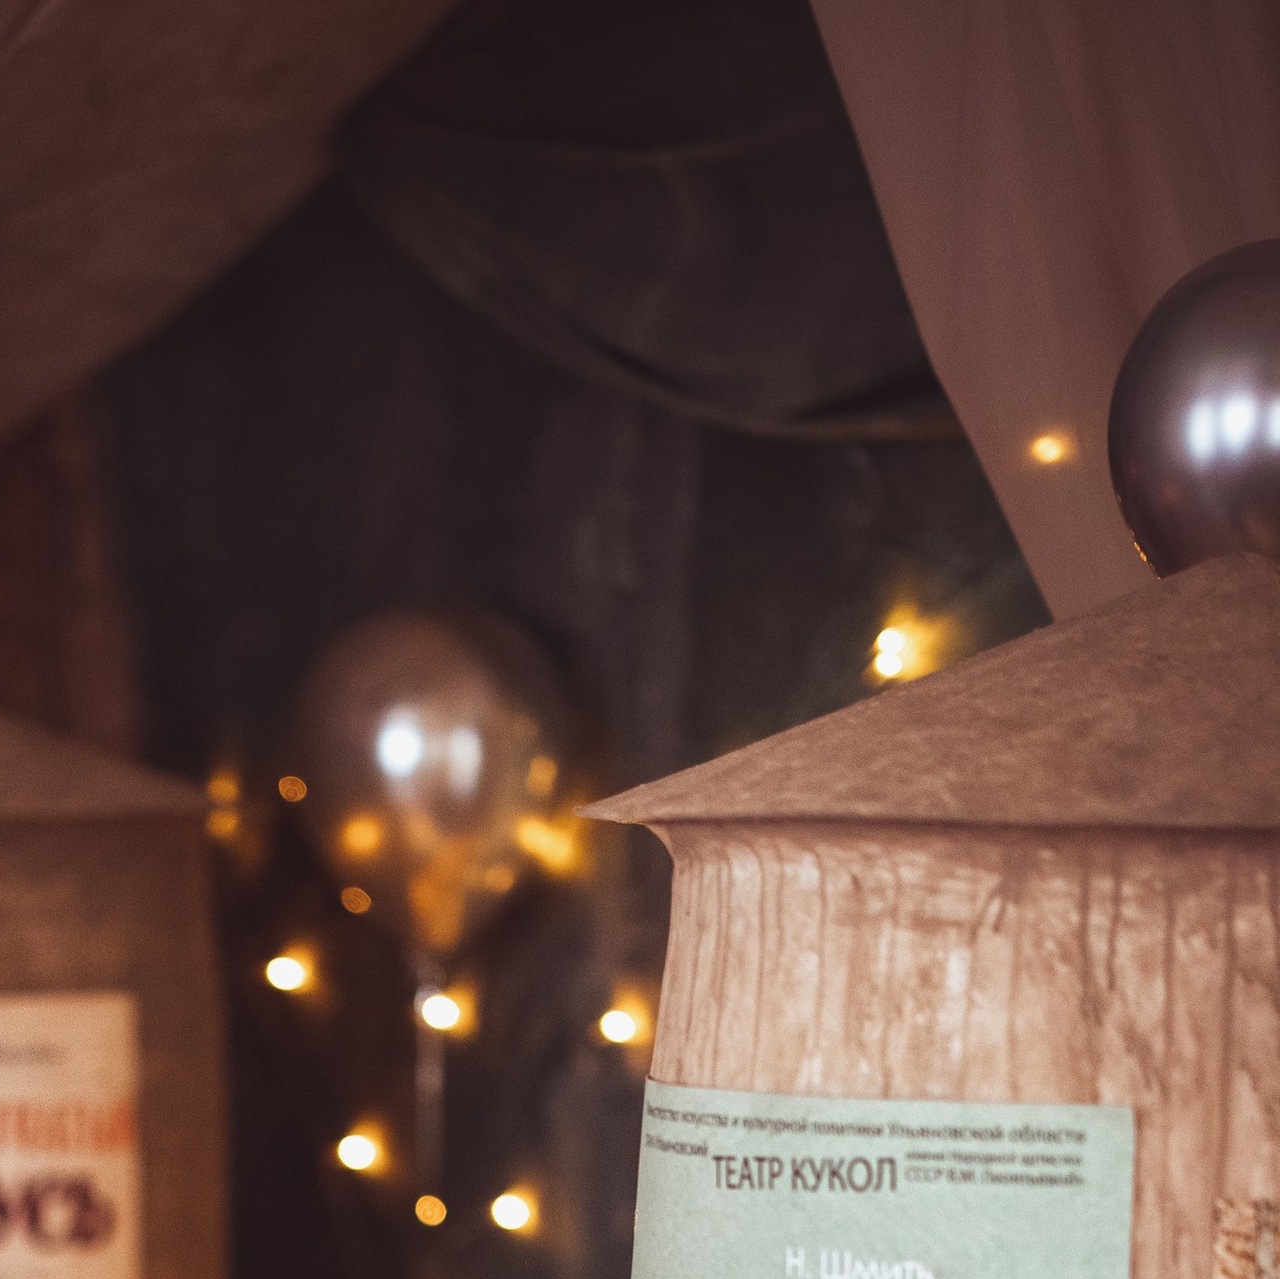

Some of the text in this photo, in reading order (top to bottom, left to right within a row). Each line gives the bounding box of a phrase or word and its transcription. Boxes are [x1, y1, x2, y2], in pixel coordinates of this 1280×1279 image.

[712, 1155, 897, 1193] ТЕАТР КУКОЛ
[786, 1247, 814, 1279] Н.
